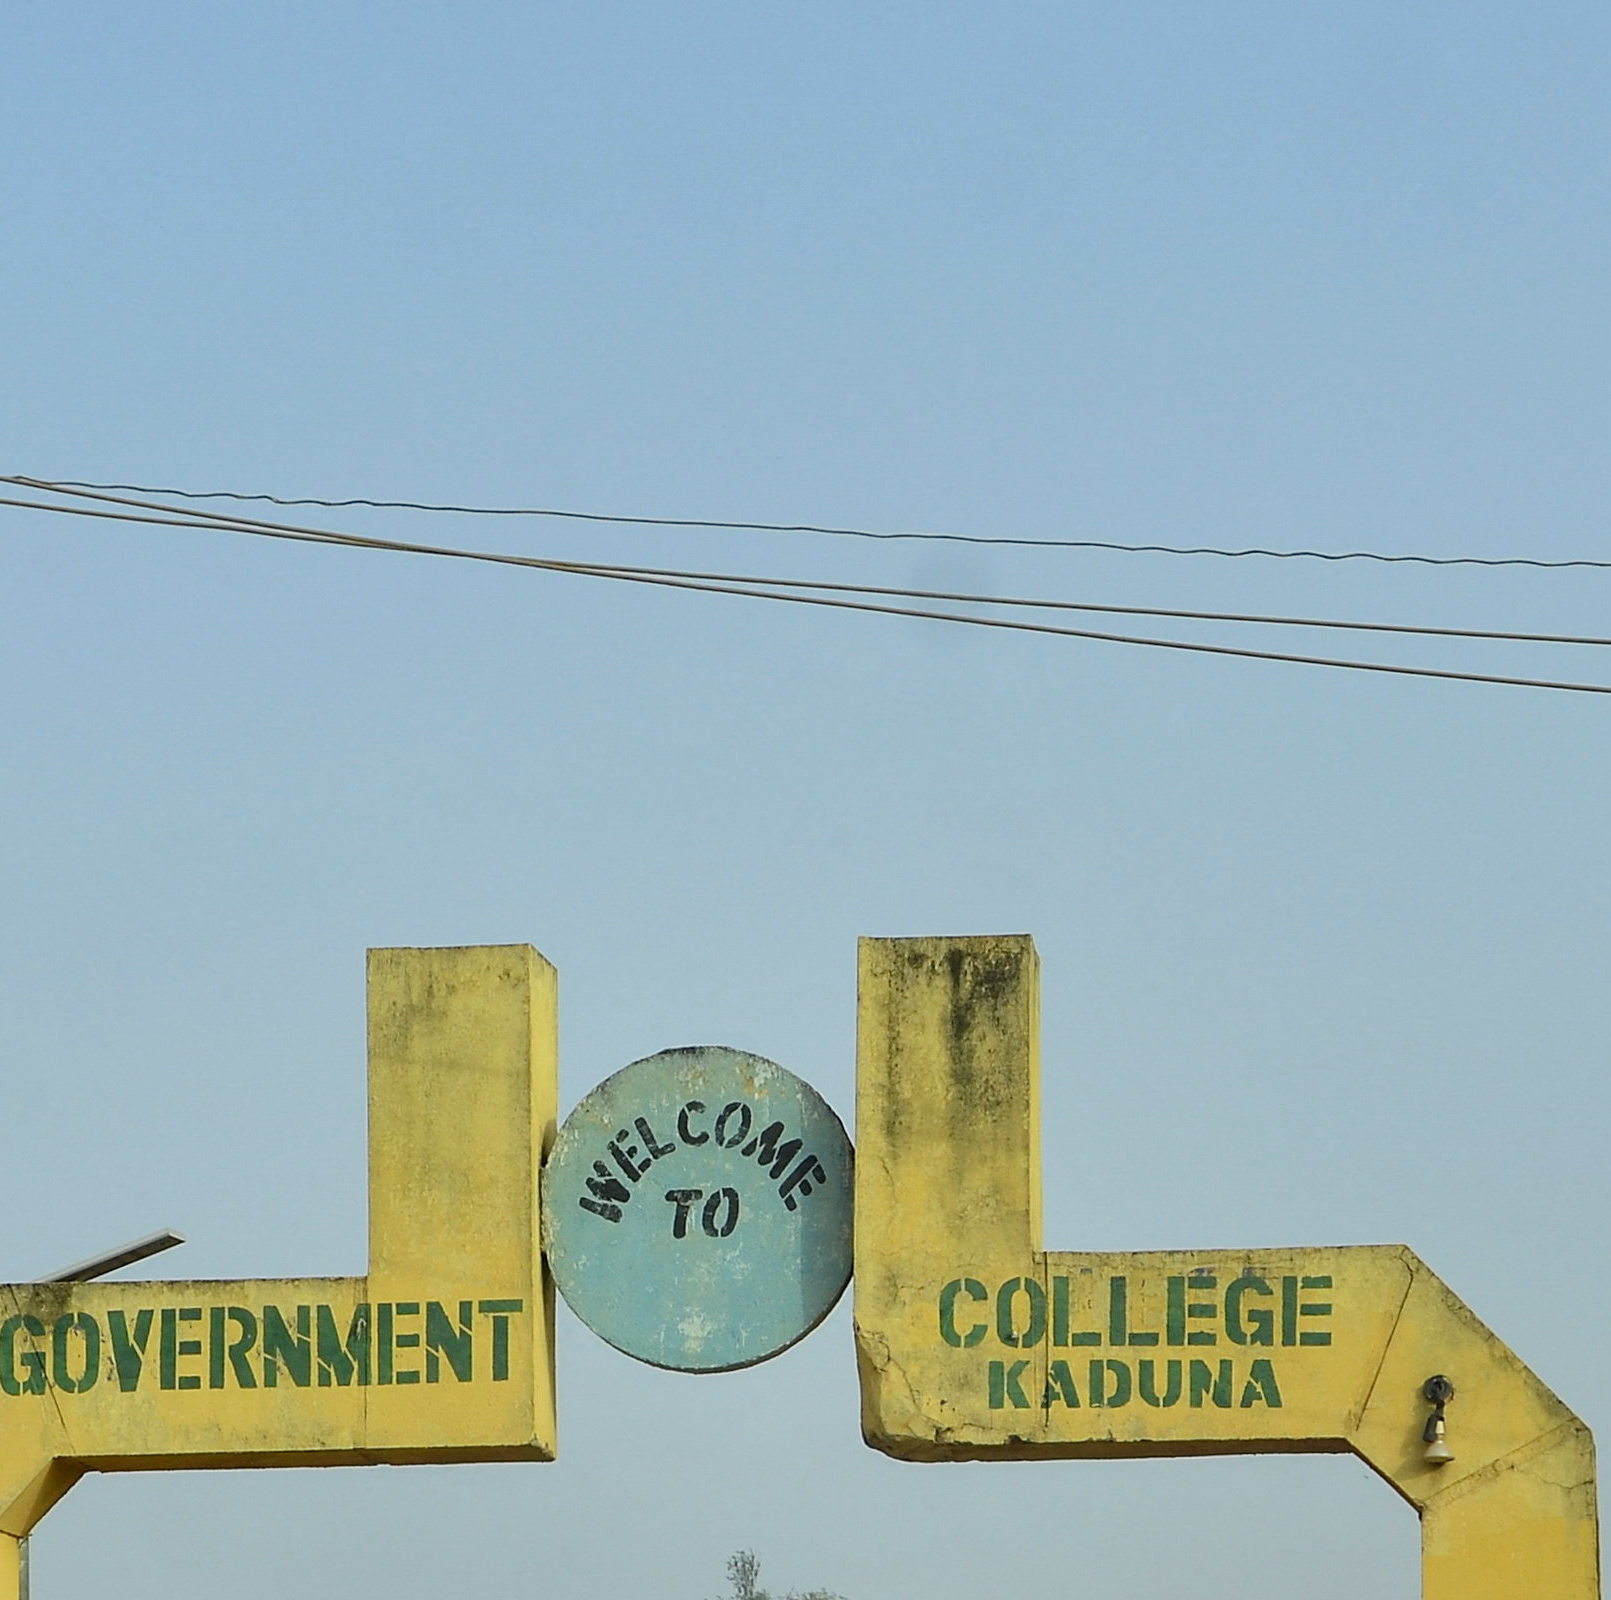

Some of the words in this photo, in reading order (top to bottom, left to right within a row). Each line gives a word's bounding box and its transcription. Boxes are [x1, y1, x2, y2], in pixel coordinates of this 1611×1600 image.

[578, 1099, 828, 1224] WELCOME
[664, 1186, 741, 1240] TO
[937, 1274, 1334, 1349] COLLEGE
[987, 1357, 1284, 1410] KADUNA
